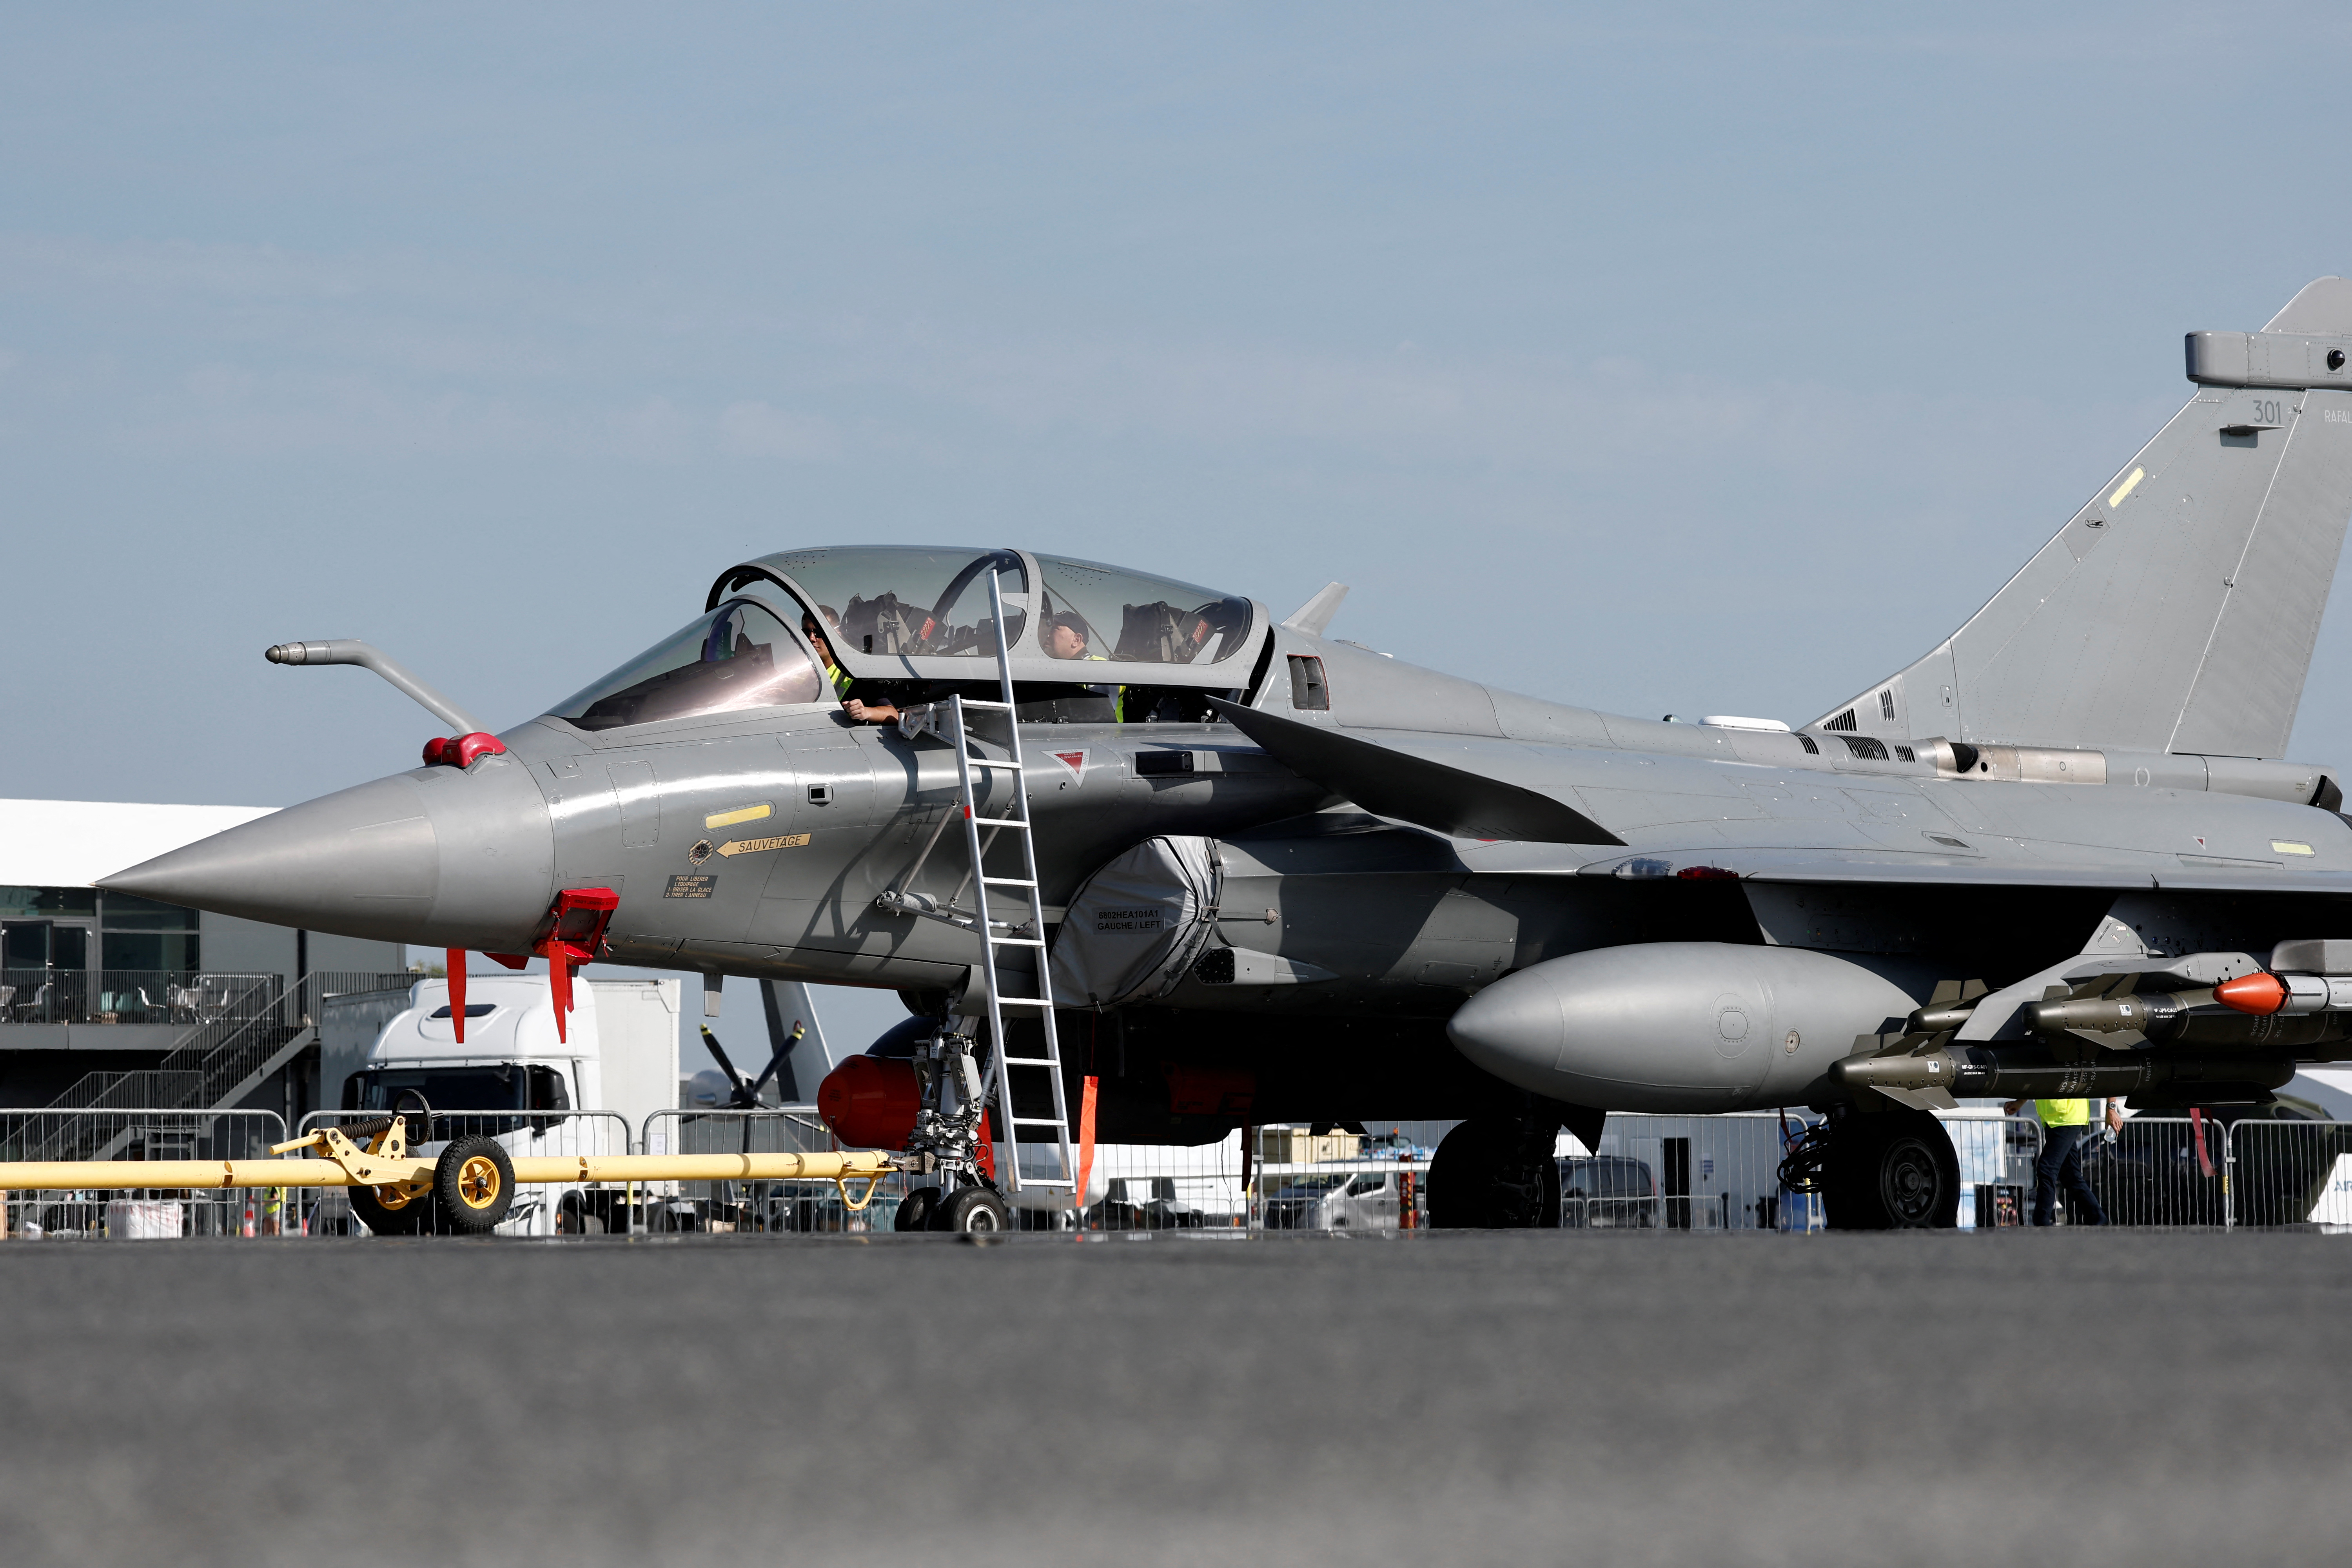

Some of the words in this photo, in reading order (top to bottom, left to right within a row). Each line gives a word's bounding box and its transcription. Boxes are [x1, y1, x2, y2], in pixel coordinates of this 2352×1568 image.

[2253, 400, 2281, 424] 301
[2325, 410, 2352, 423] RAFAL
[1054, 757, 1074, 774] DANGER
[739, 835, 802, 852] SAUVETAGE
[1098, 910, 1158, 919] 6802HEA101A1
[1098, 922, 1132, 930] GAUCHE
